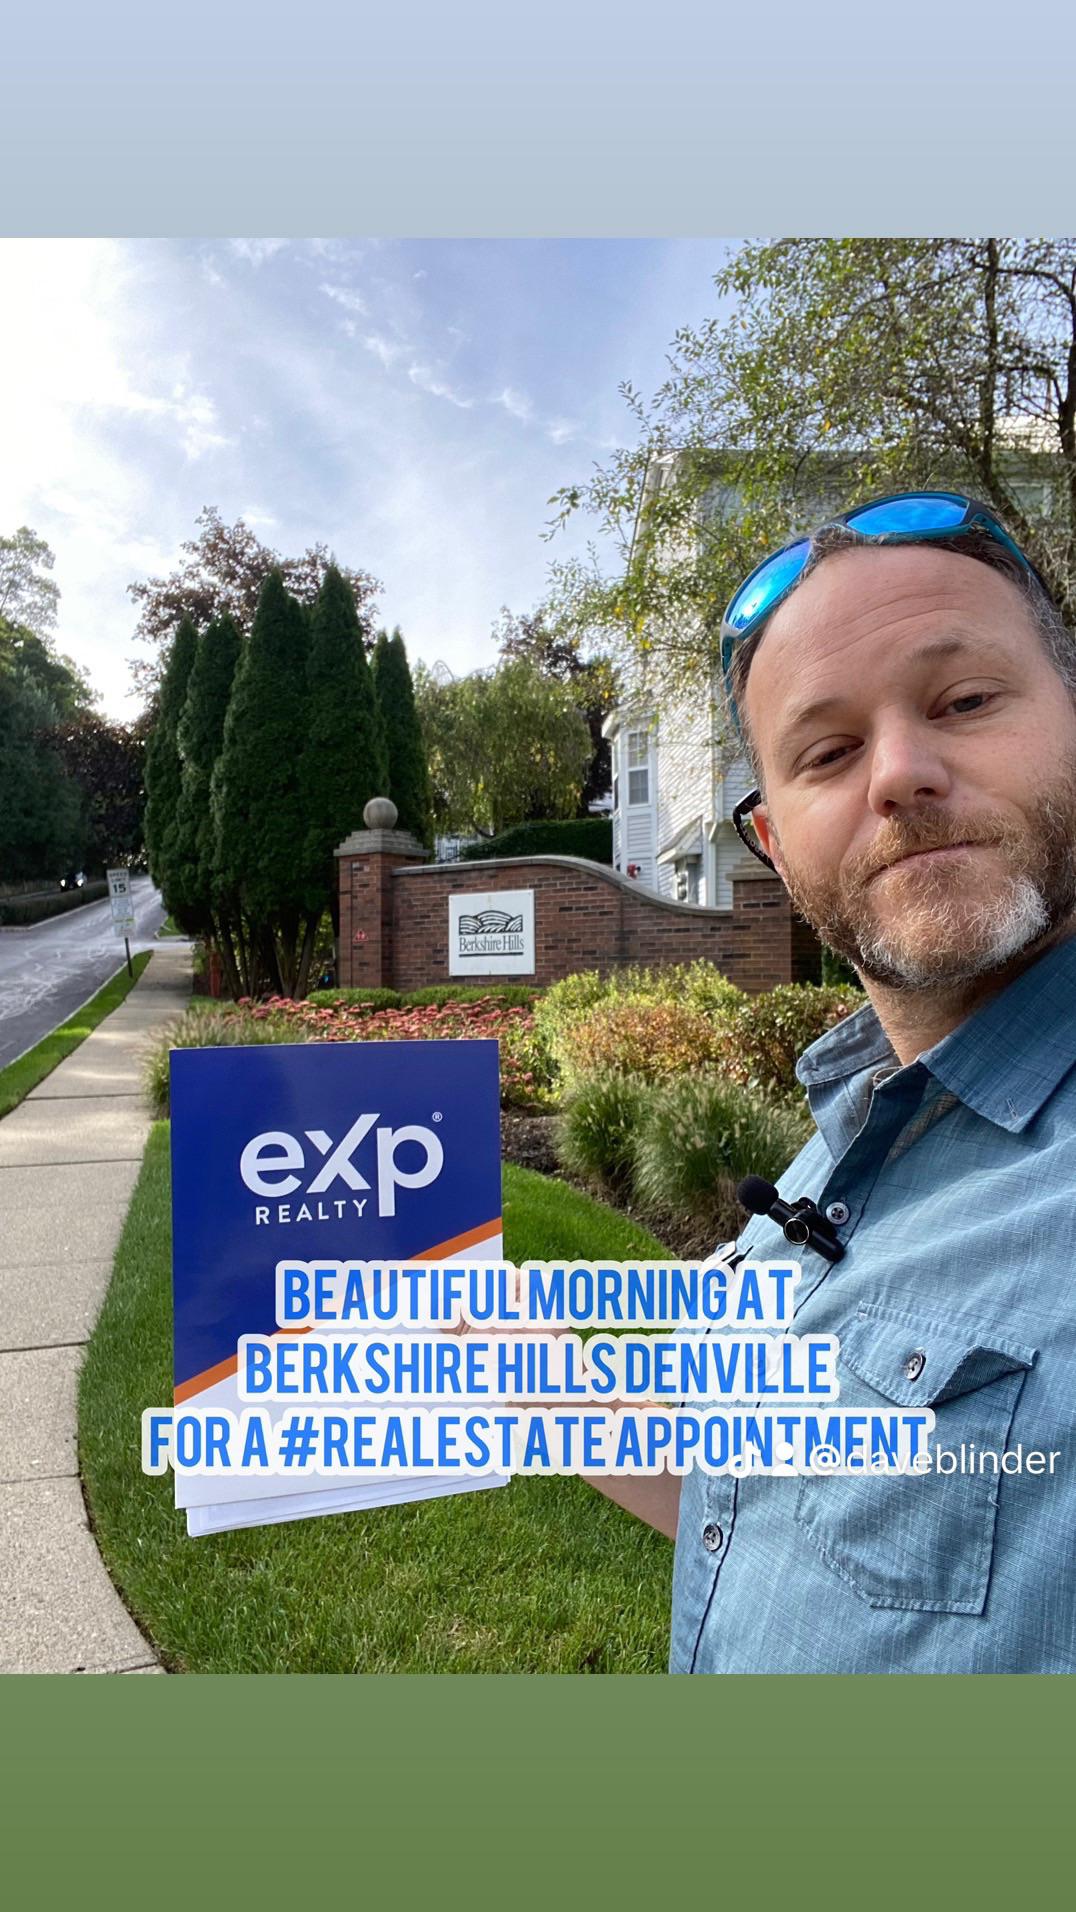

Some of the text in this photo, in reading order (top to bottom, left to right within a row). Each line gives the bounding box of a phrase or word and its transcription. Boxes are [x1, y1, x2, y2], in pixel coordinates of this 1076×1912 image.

[112, 883, 126, 893] 15
[459, 934, 525, 952] Berkshire Hills
[255, 1199, 367, 1225] REALTY
